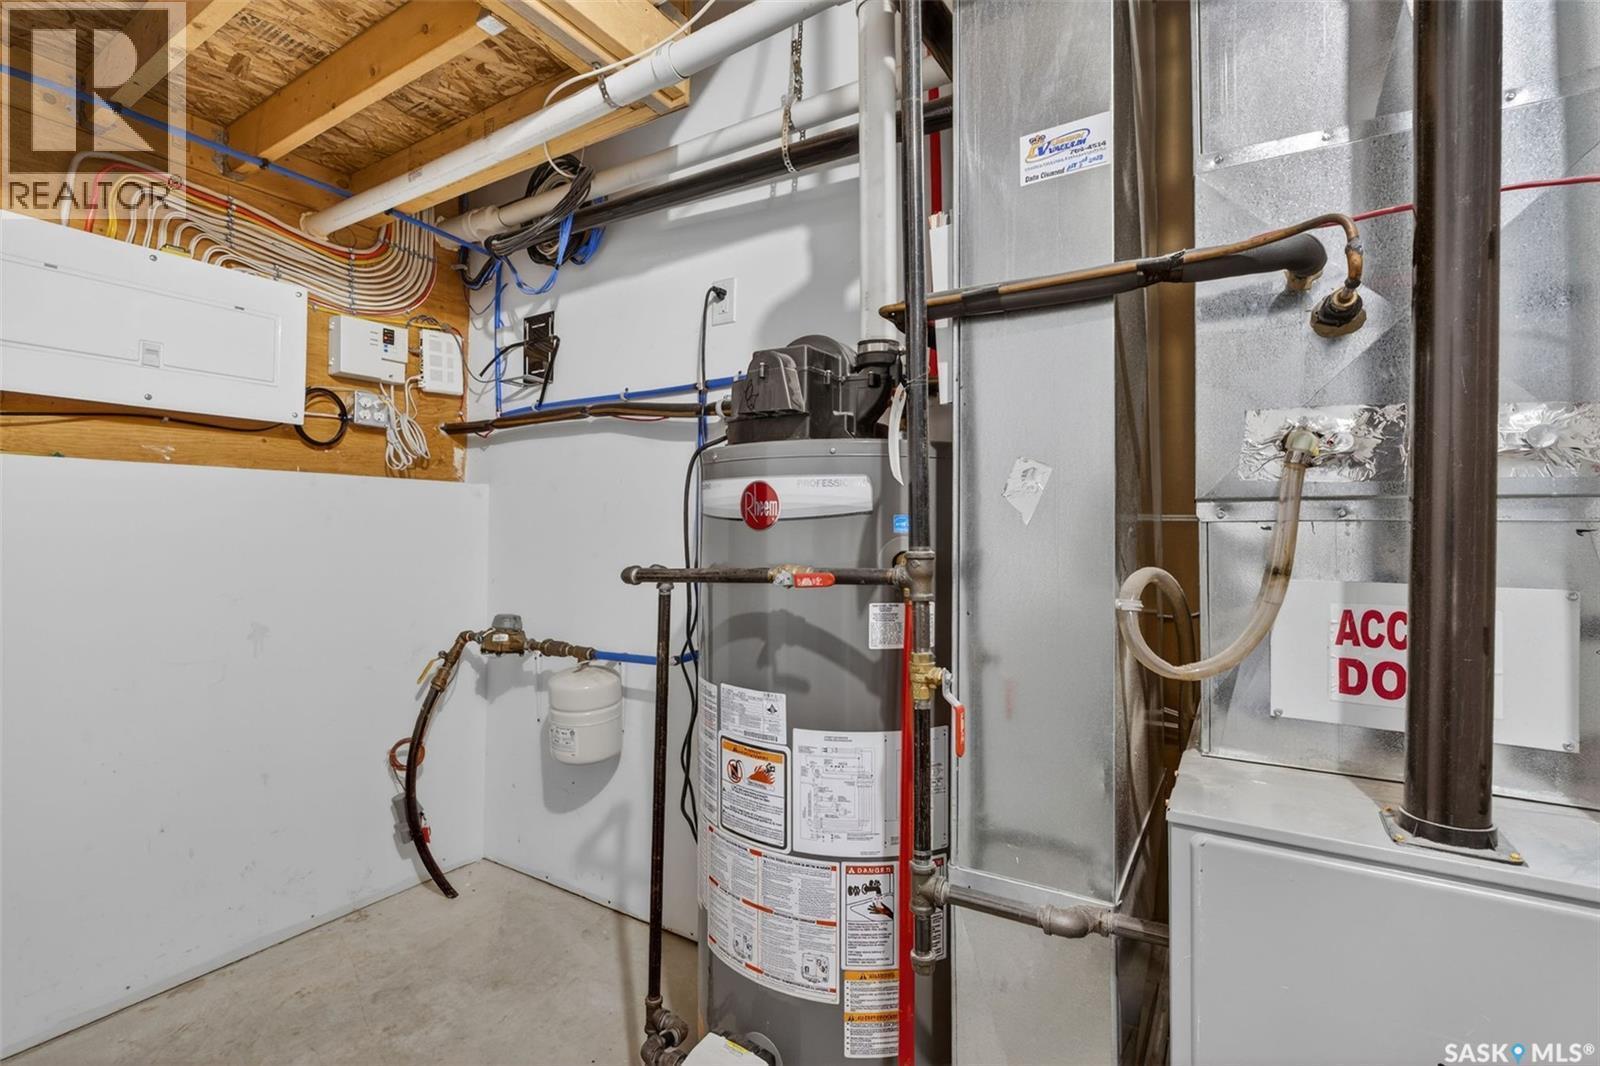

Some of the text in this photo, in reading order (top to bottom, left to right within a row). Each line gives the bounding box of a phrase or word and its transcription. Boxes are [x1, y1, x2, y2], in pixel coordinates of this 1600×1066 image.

[744, 483, 778, 523] Rheem
[1335, 609, 1408, 650] ACC
[1339, 657, 1408, 701] DO
